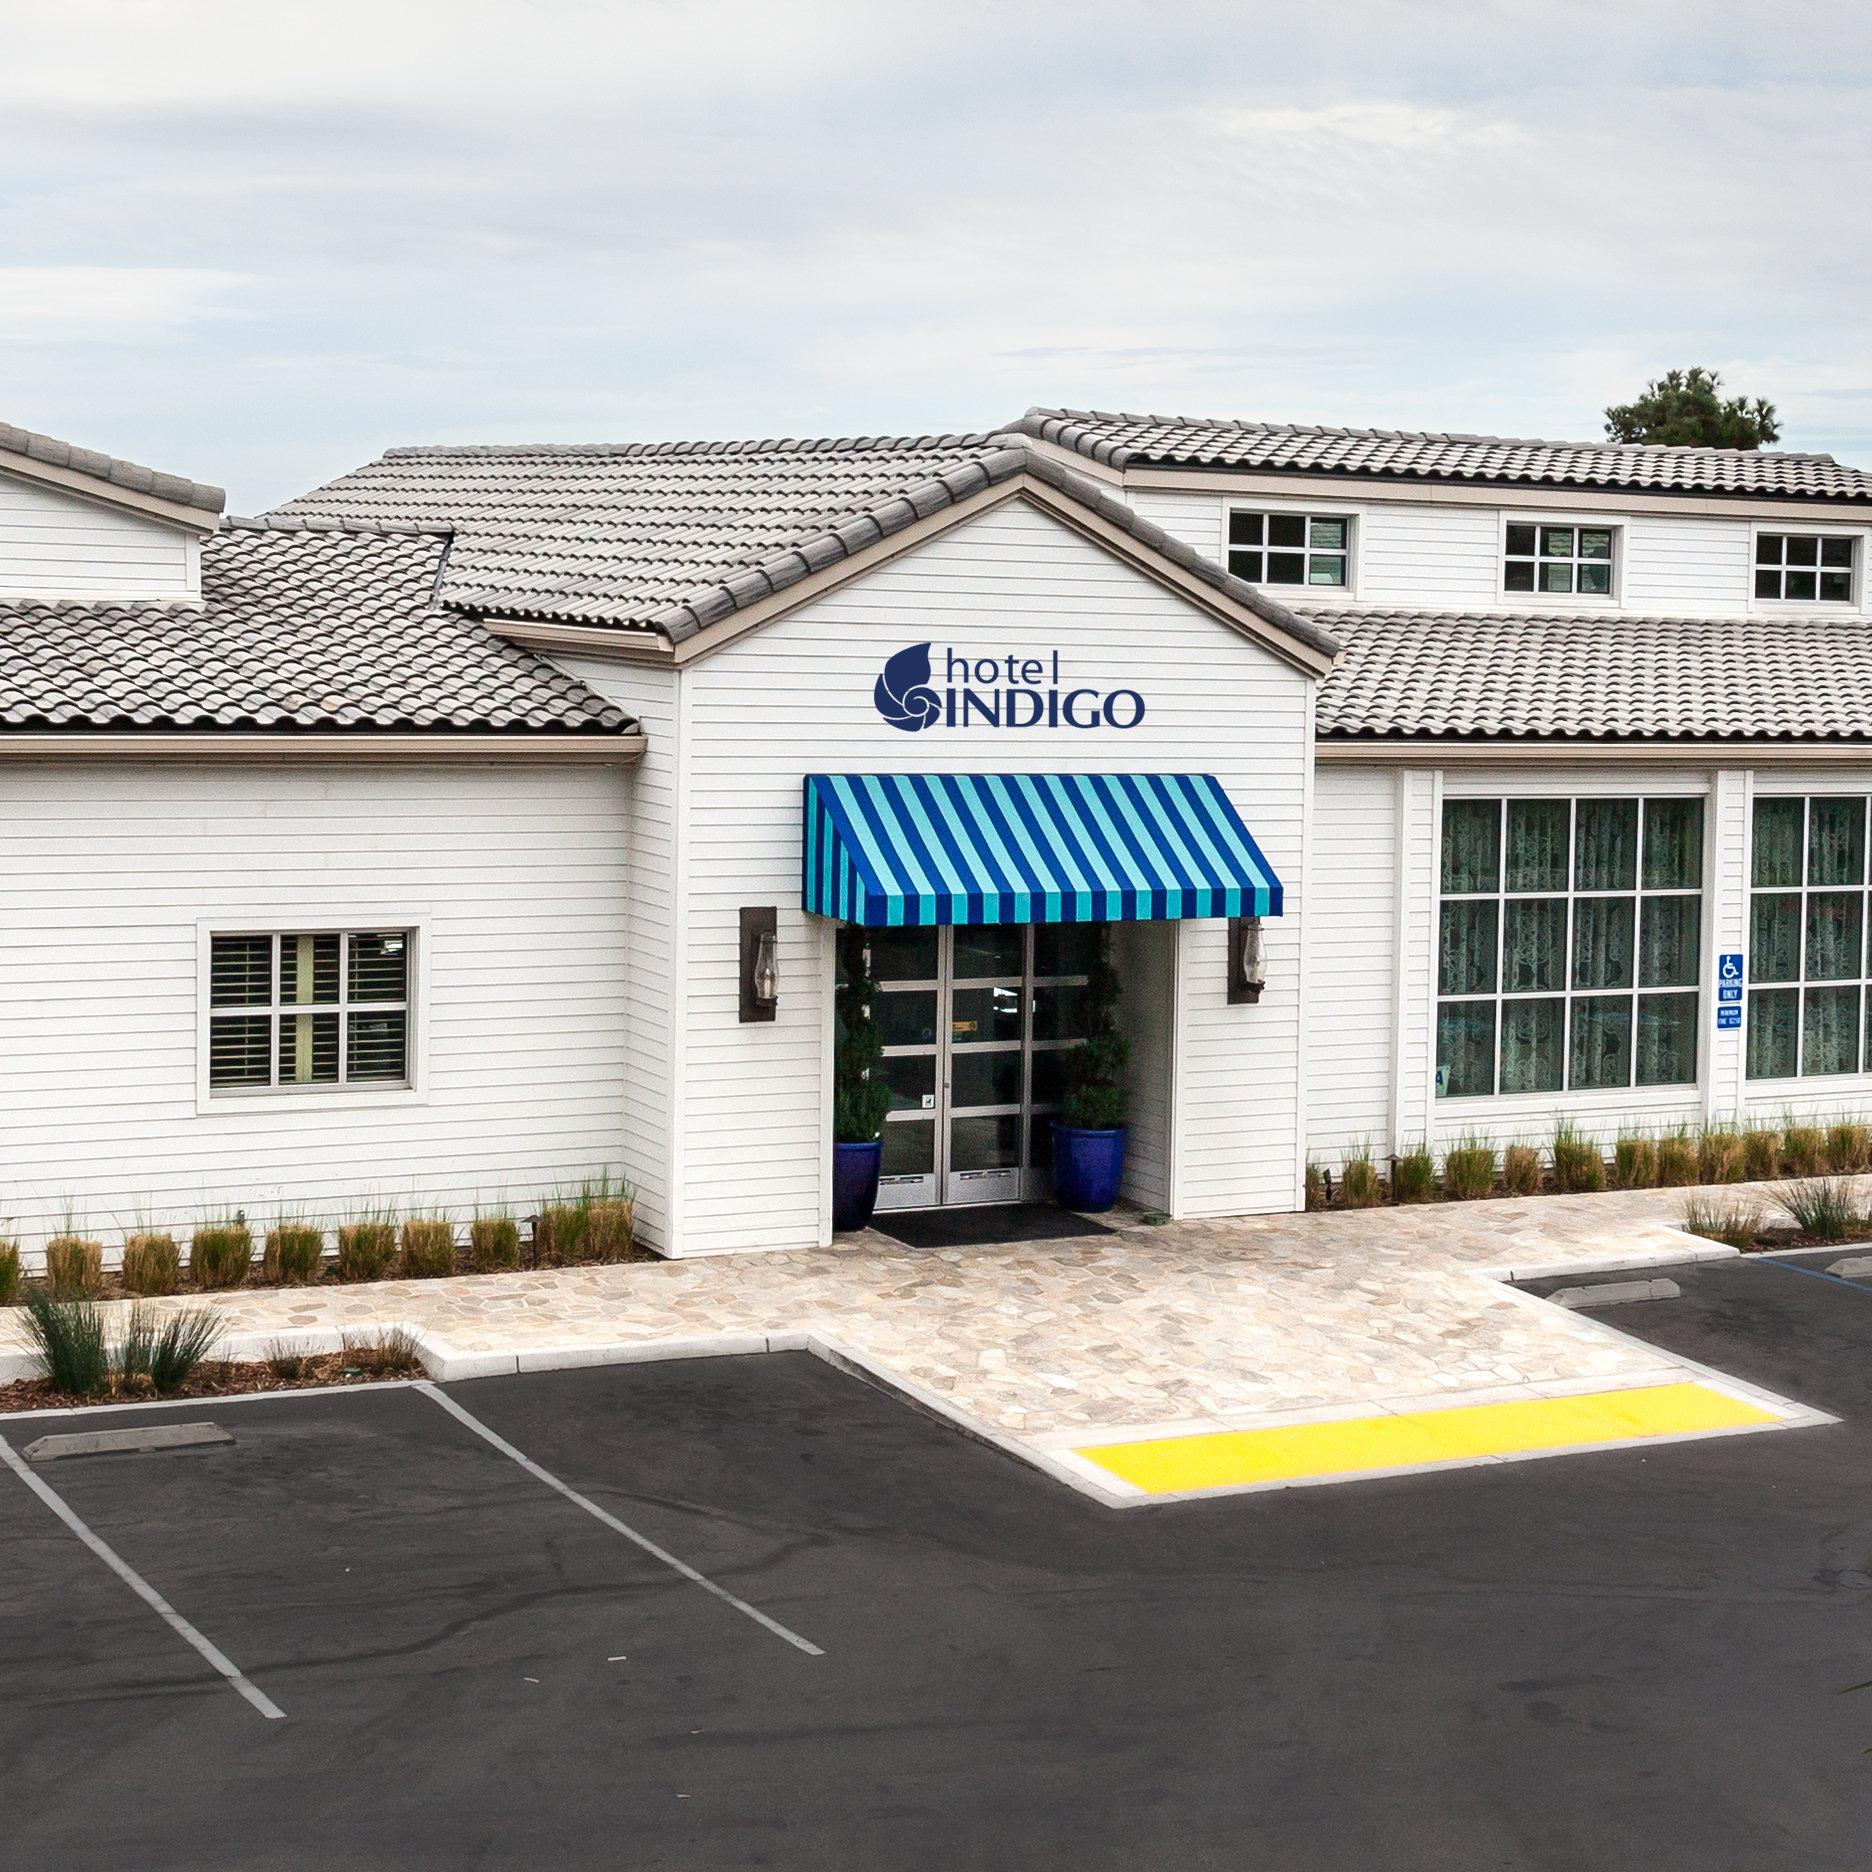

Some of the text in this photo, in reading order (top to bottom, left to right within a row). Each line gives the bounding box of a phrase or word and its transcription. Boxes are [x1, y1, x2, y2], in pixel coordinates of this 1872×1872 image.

[947, 648, 1058, 684] hotel
[946, 688, 1145, 729] INDIGO
[1719, 978, 1744, 989] PARKING
[1722, 989, 1738, 999] ONLY
